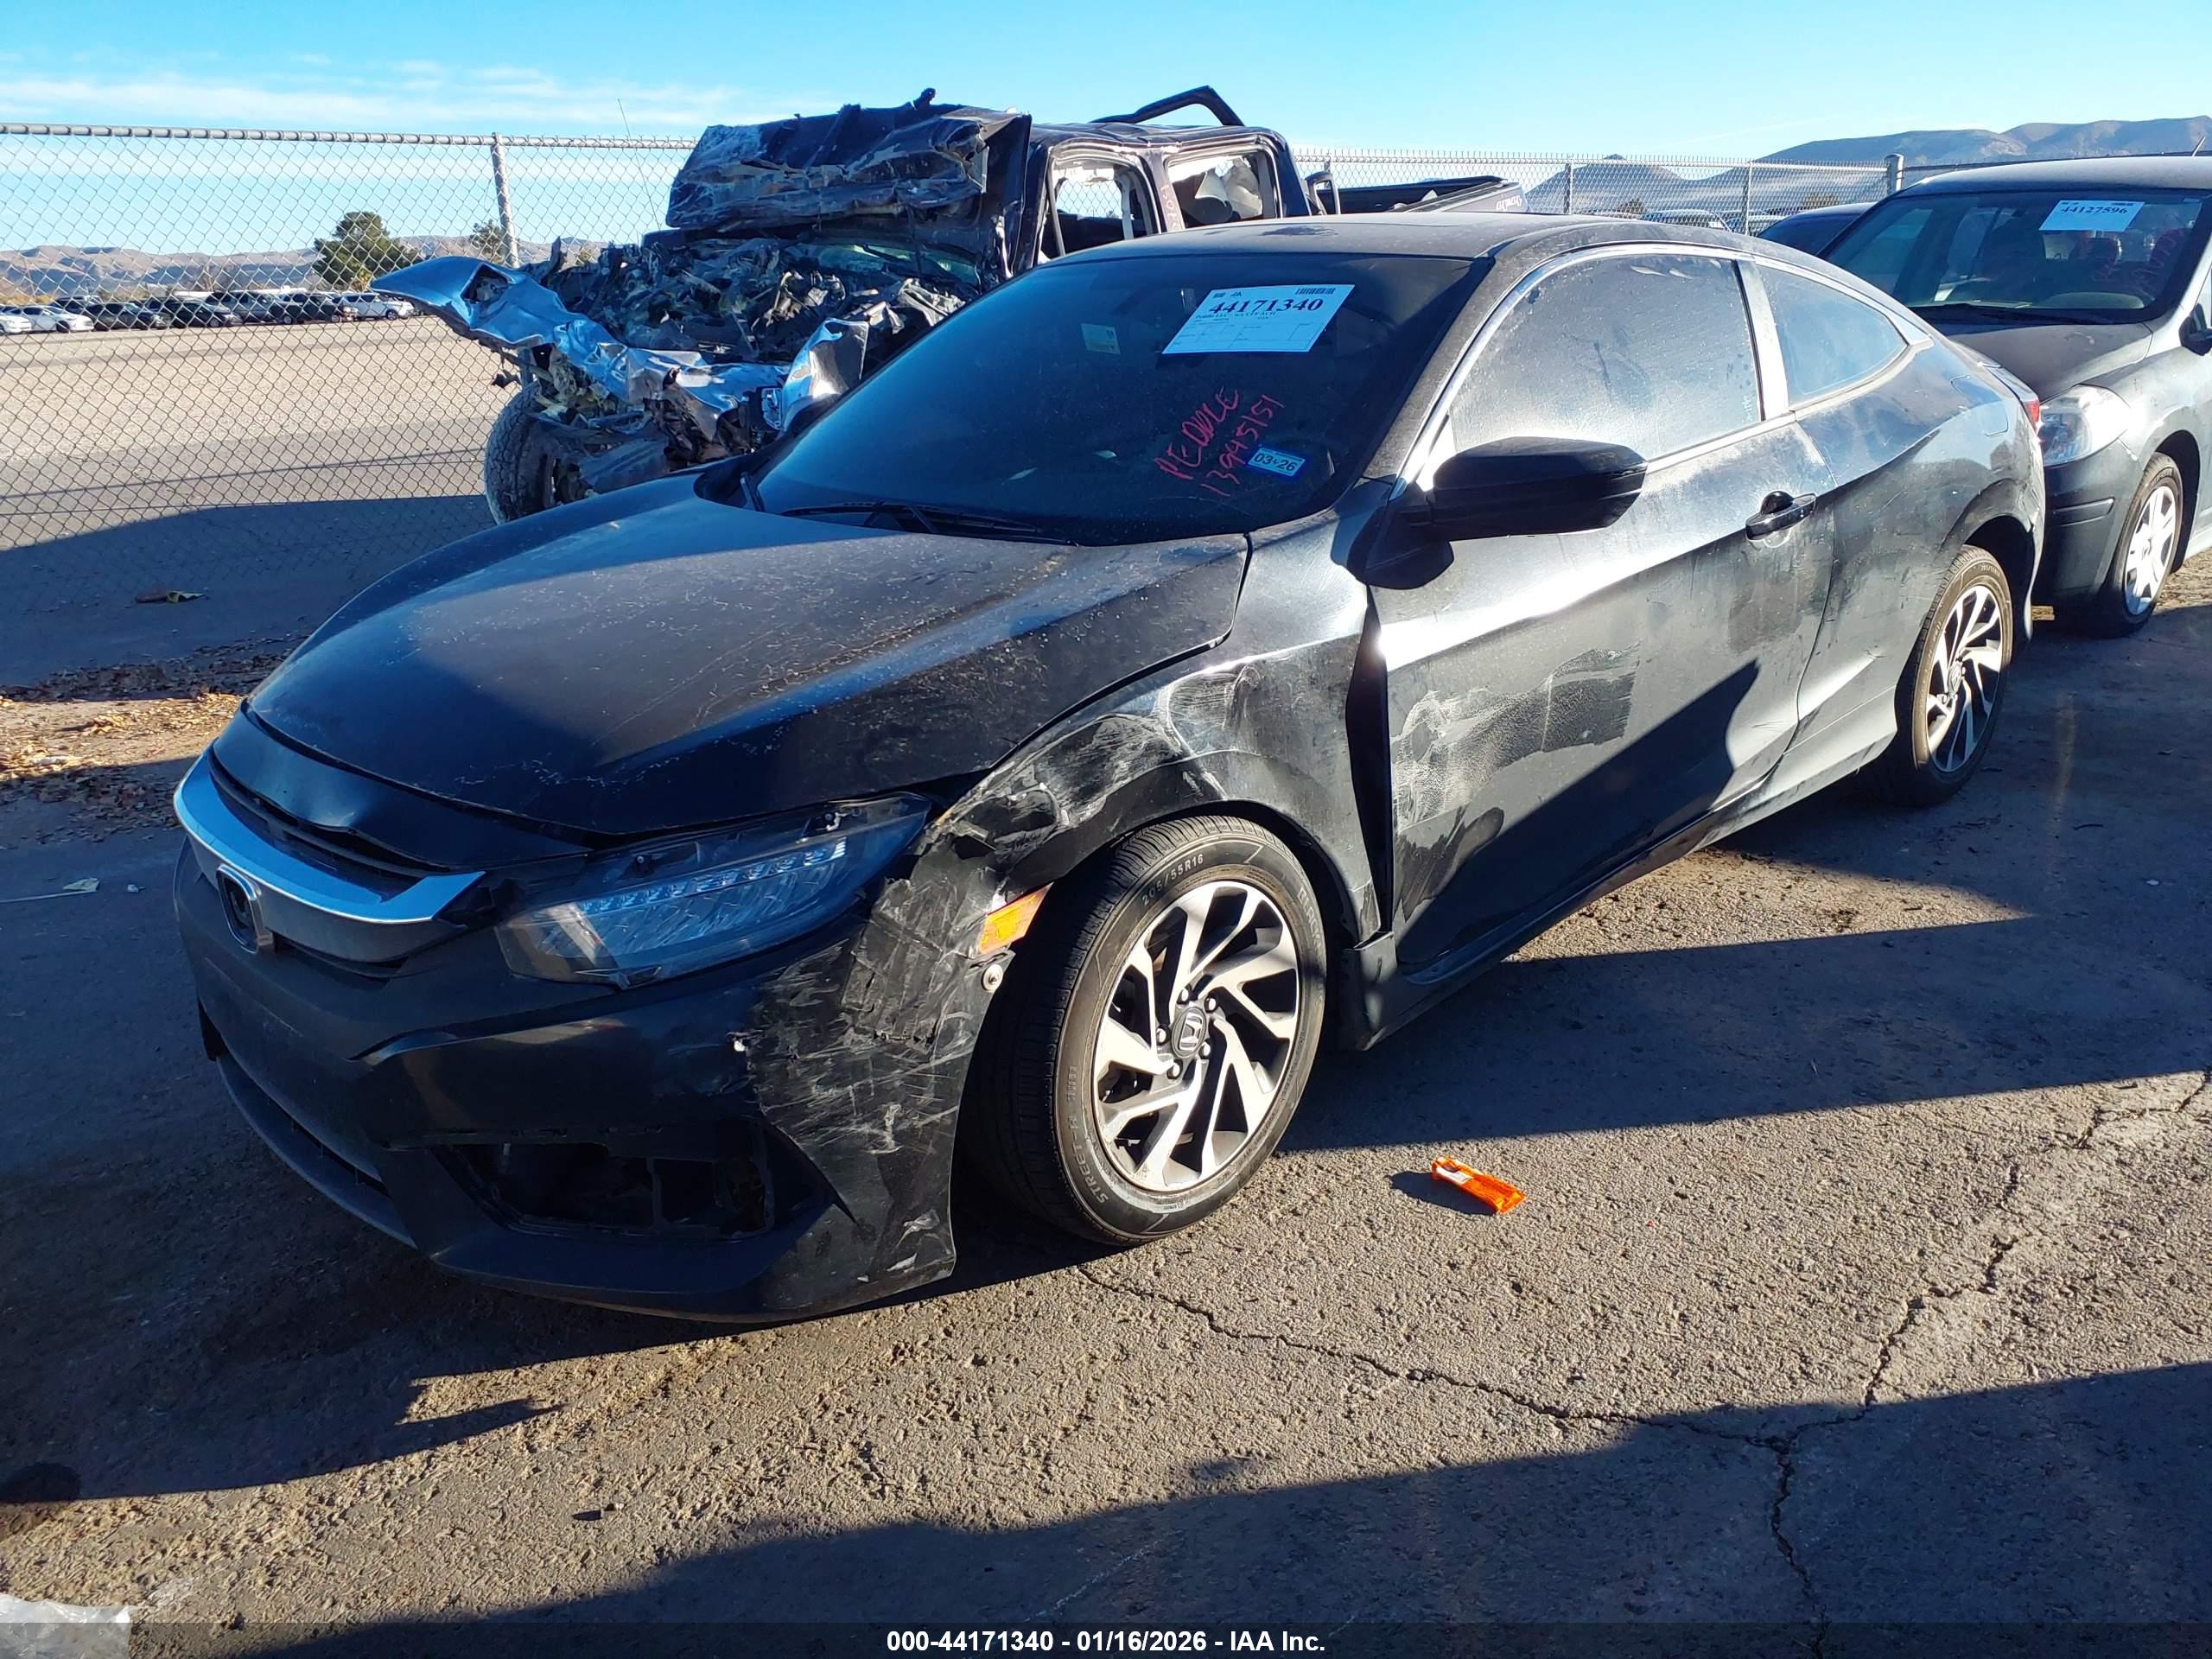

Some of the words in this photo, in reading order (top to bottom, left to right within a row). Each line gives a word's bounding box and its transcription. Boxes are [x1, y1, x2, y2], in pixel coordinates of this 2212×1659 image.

[1209, 298, 1324, 314] 44171340
[1255, 453, 1273, 465] 03
[1277, 460, 1297, 472] 26
[1141, 853, 1204, 906] 205/55R16
